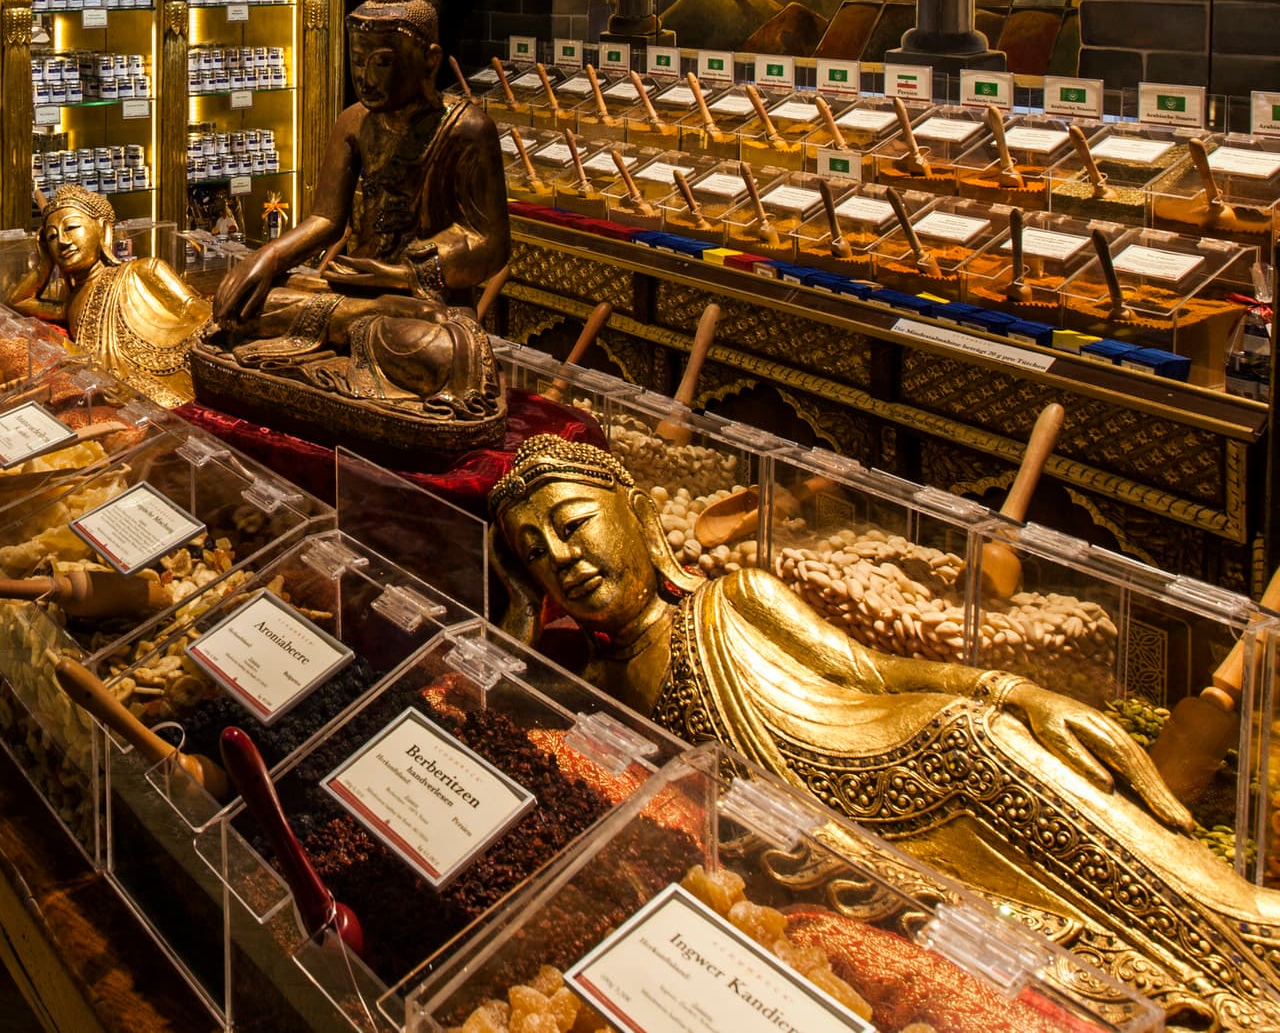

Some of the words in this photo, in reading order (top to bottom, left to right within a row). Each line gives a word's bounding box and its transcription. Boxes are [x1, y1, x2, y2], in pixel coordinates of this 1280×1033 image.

[906, 329, 961, 347] Mindestabnahme
[962, 343, 987, 355] beträgt
[1017, 357, 1046, 370] Tütchen
[254, 621, 310, 666] Aroniabeere
[405, 743, 481, 809] Berberitzen
[406, 766, 454, 808] handverlesen
[669, 932, 726, 979] Ingwer
